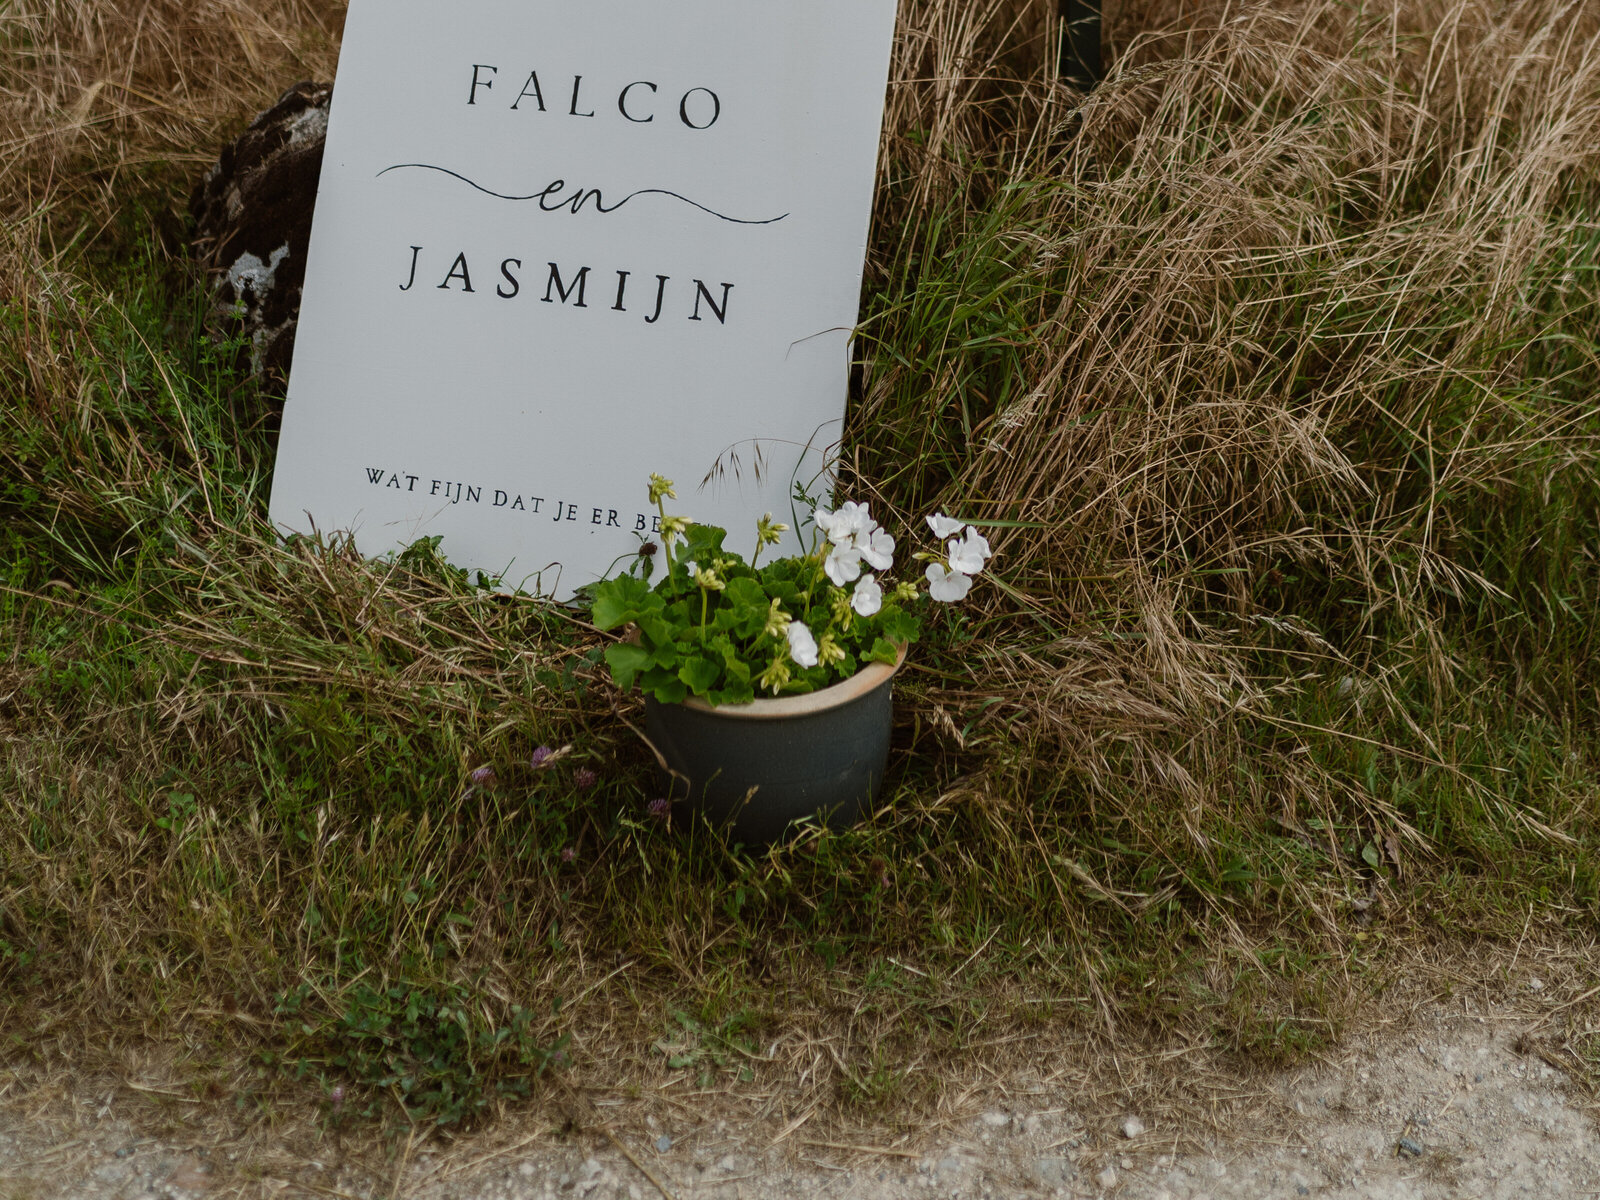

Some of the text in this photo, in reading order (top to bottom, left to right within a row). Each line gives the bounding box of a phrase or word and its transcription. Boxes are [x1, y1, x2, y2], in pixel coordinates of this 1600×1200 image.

[467, 64, 721, 130] FALCO
[399, 245, 735, 325] JASMIJN
[365, 467, 419, 492] WAT
[429, 480, 483, 504] FIJN
[492, 490, 545, 514] DAT
[553, 501, 578, 522] JE
[591, 508, 621, 528] ER
